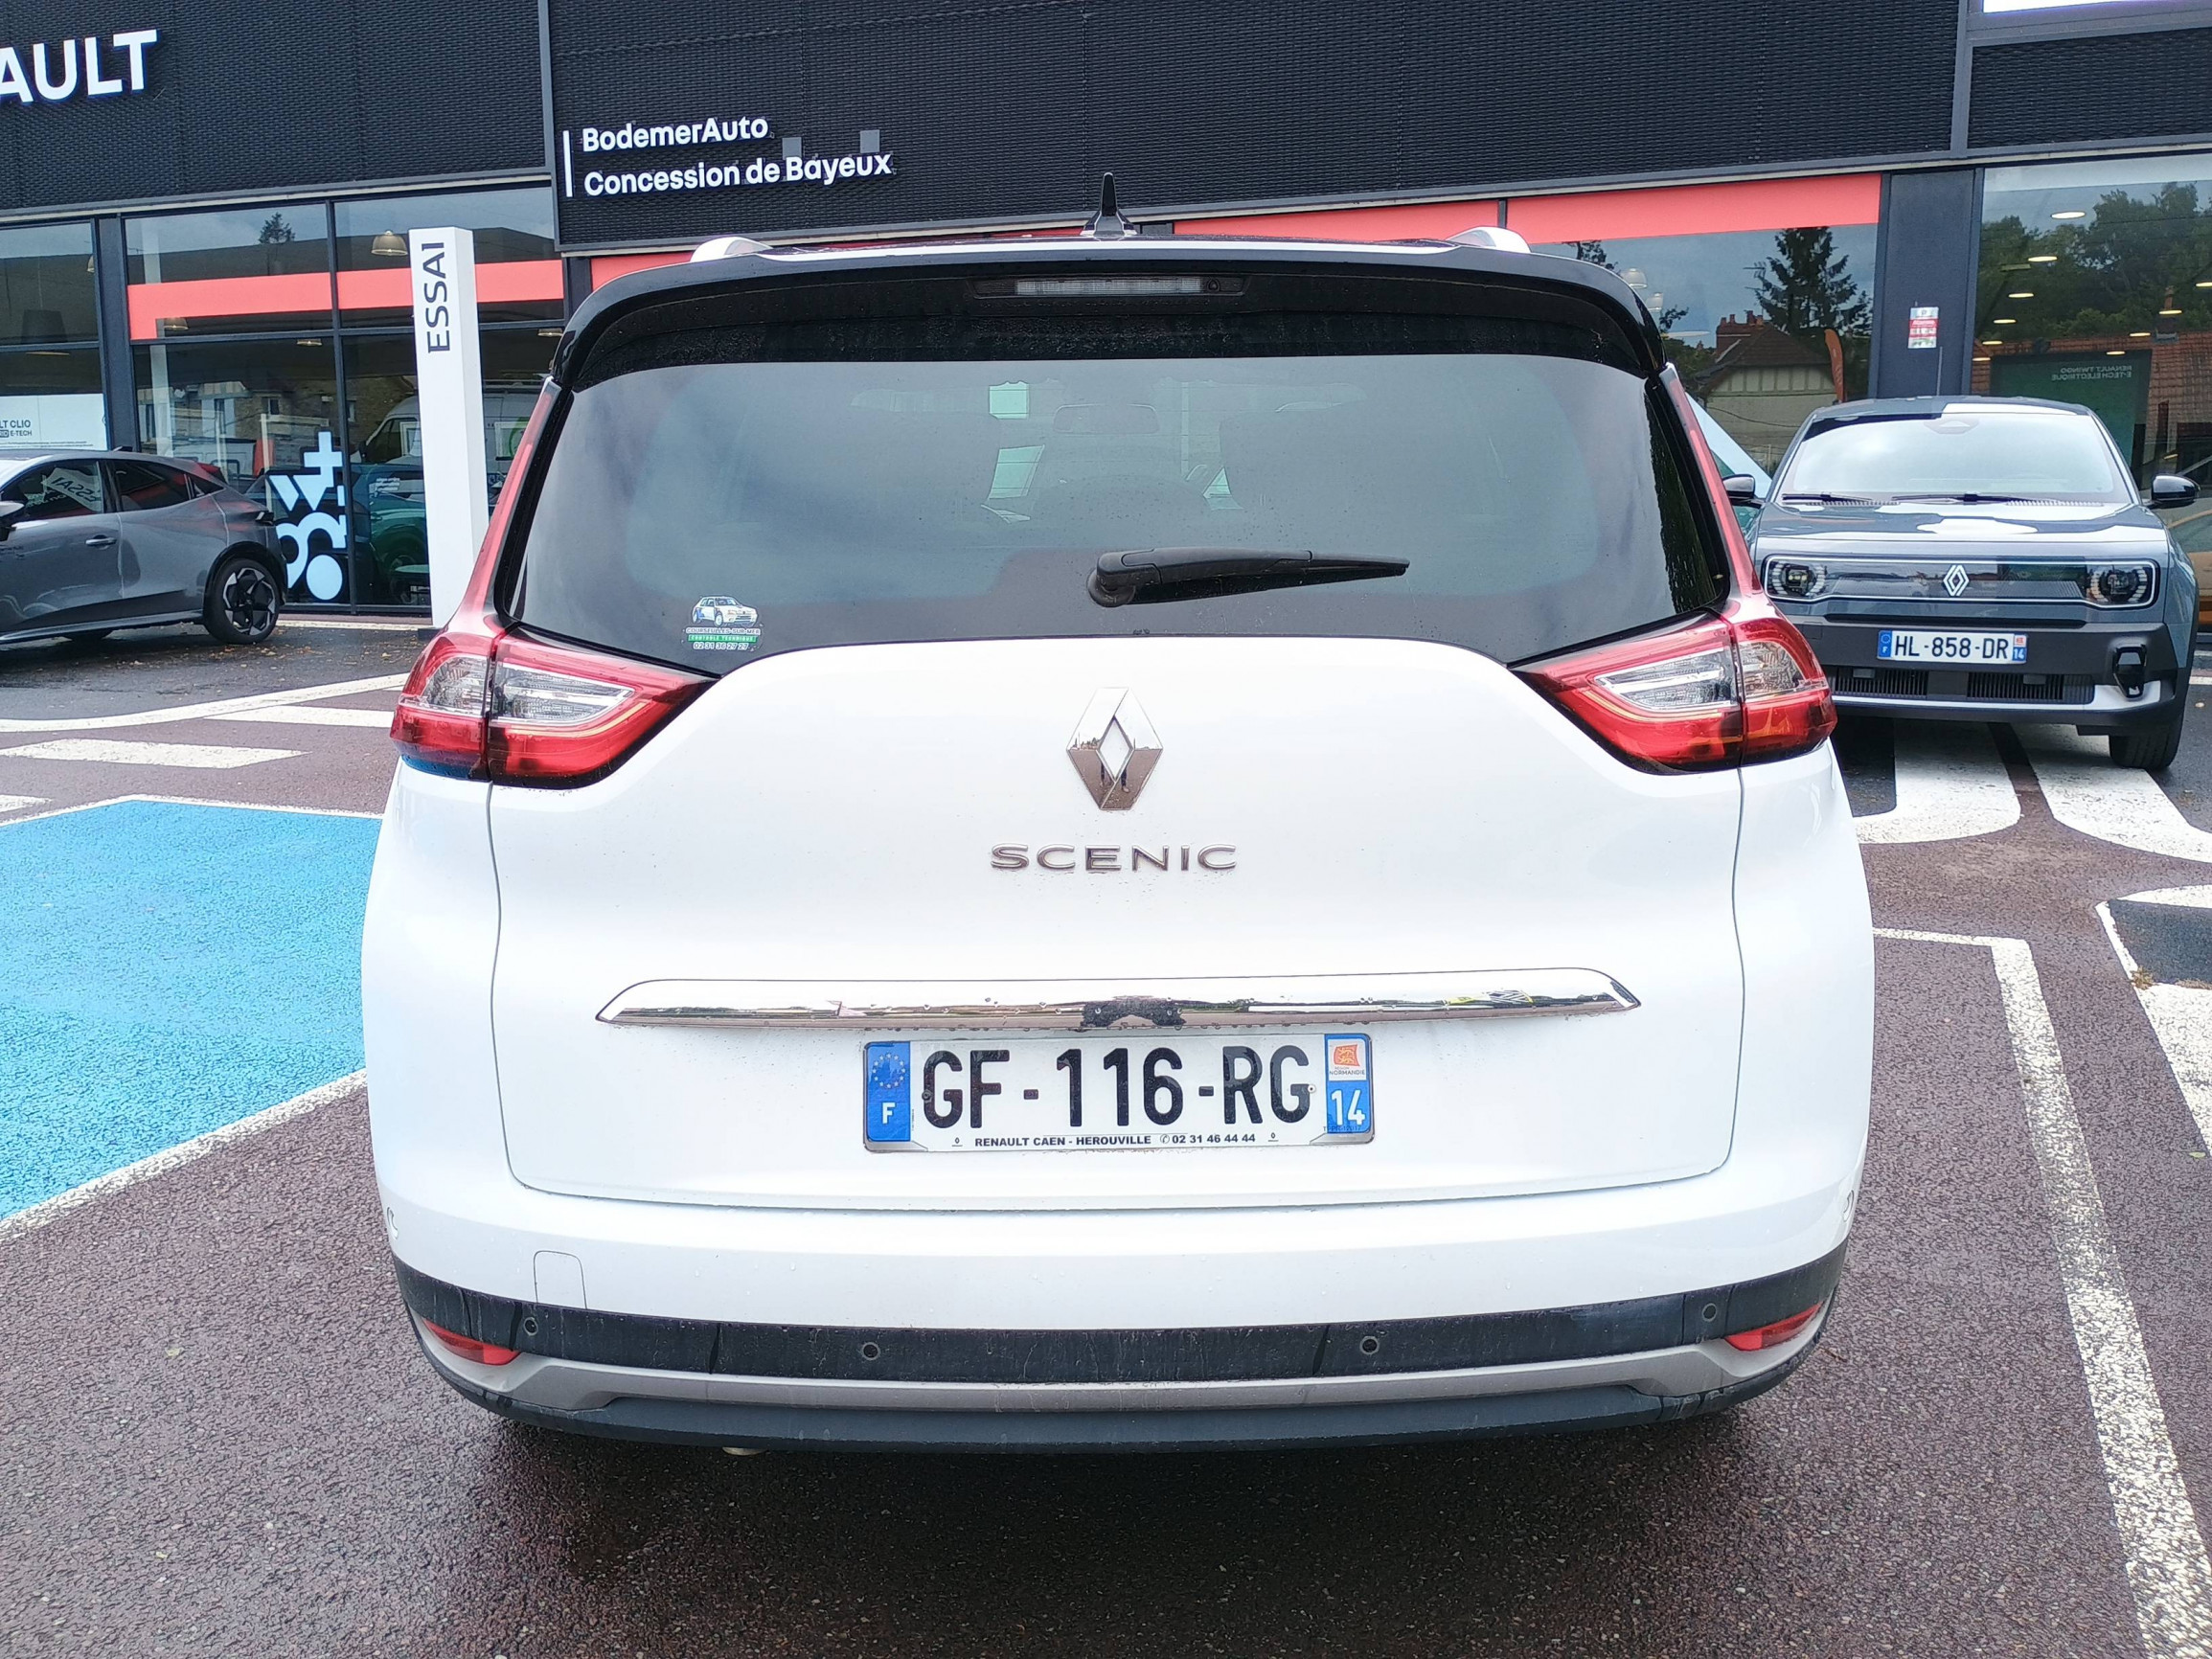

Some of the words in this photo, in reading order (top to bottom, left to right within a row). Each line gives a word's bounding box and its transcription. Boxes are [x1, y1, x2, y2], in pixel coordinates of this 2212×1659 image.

[582, 117, 768, 152] BodemerAuto
[584, 161, 740, 196] Concession
[745, 158, 780, 184] de
[786, 153, 893, 186] Bayeux
[422, 242, 450, 353] ESSAI
[10, 420, 32, 428] CLIO
[1894, 635, 2009, 659] HL-858-DR
[991, 844, 1237, 871] SCENIC
[923, 1044, 1311, 1129] GF-116-RG
[882, 1102, 896, 1124] F
[1331, 1089, 1365, 1125] 14
[974, 1137, 1030, 1147] RENAULT
[1033, 1137, 1066, 1146] CAEN
[1076, 1135, 1152, 1146] HEROUVILLE
[1172, 1135, 1186, 1144] 02
[1189, 1134, 1202, 1144] 31
[1206, 1134, 1220, 1143] 46
[1224, 1134, 1239, 1143] 44
[1242, 1134, 1256, 1143] 44
